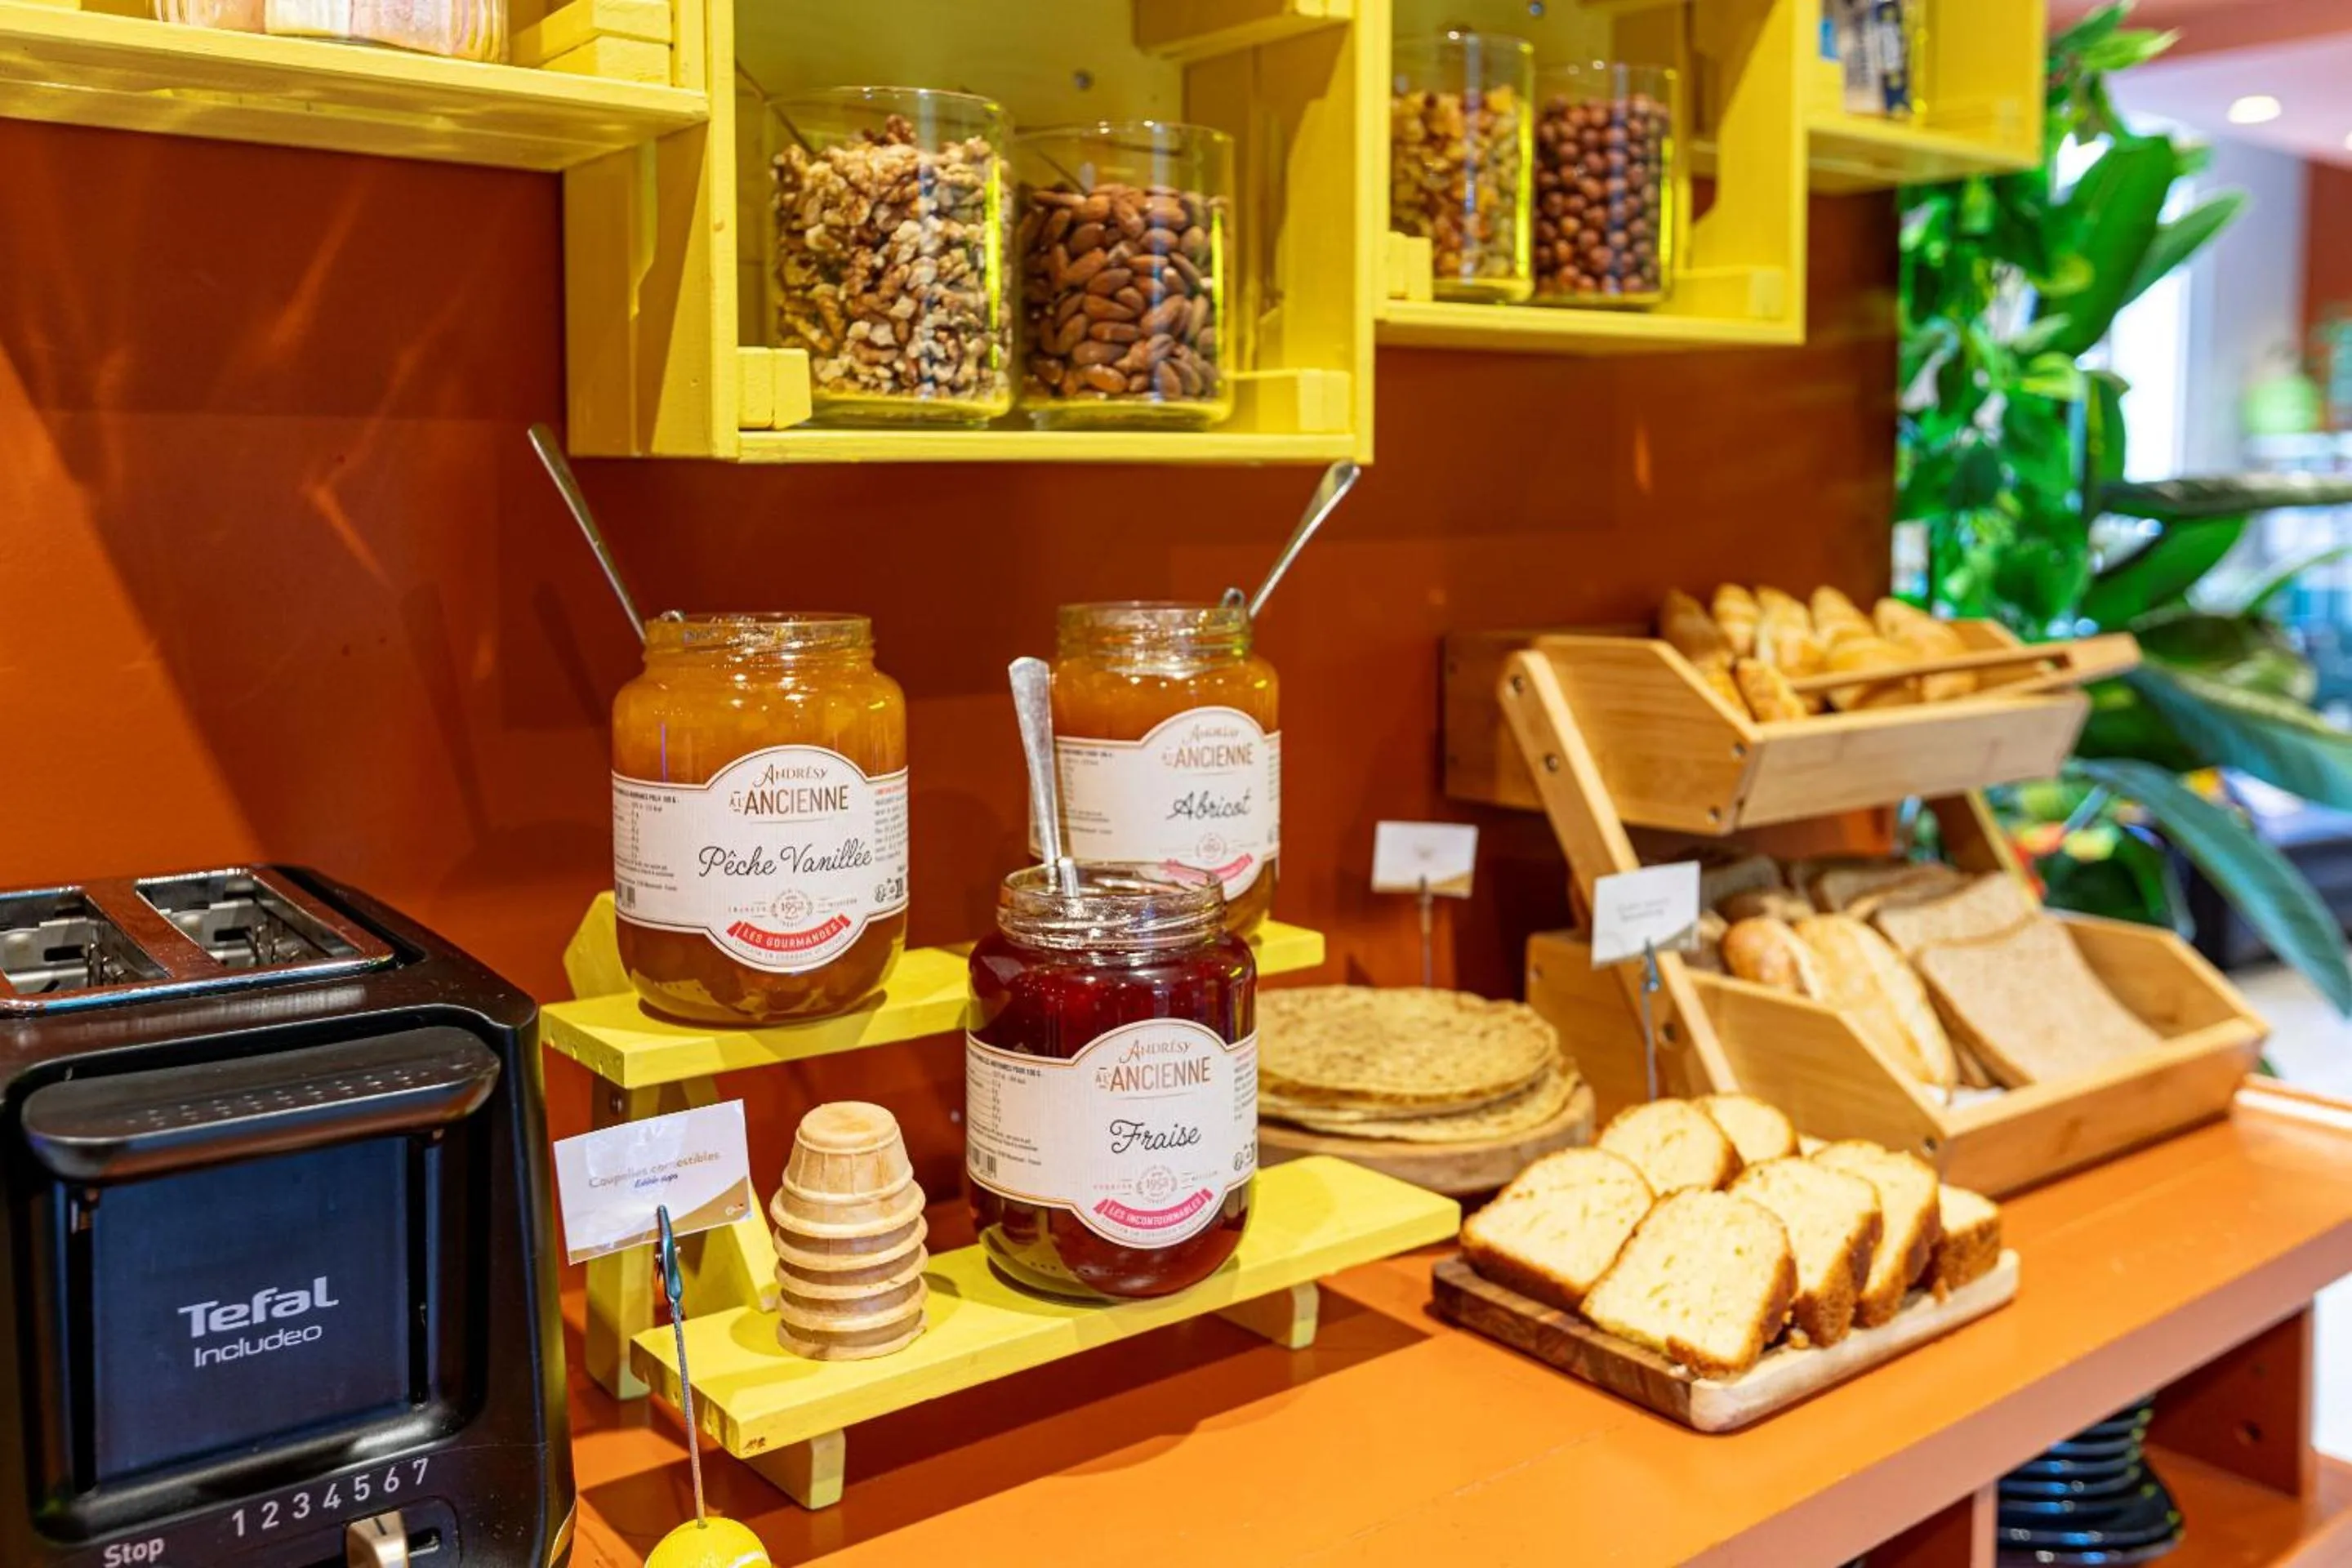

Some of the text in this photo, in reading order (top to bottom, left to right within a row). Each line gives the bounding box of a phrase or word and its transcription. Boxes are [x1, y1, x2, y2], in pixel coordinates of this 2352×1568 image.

[1174, 742, 1254, 768] ANCIENNE
[744, 786, 849, 815] ANCIENNE
[1165, 787, 1251, 821] Abricot
[699, 845, 777, 878] Pêche
[780, 838, 873, 874] Vanillée
[742, 922, 838, 949] LES GOURMANDES
[1110, 1057, 1210, 1092] ANCIENNE
[1110, 1119, 1202, 1154] Fraise
[177, 1276, 340, 1339] Tefal
[194, 1325, 323, 1368] Includeo
[231, 1457, 429, 1537] 1 2 3 4 5 6 7
[103, 1537, 165, 1568] Stop
